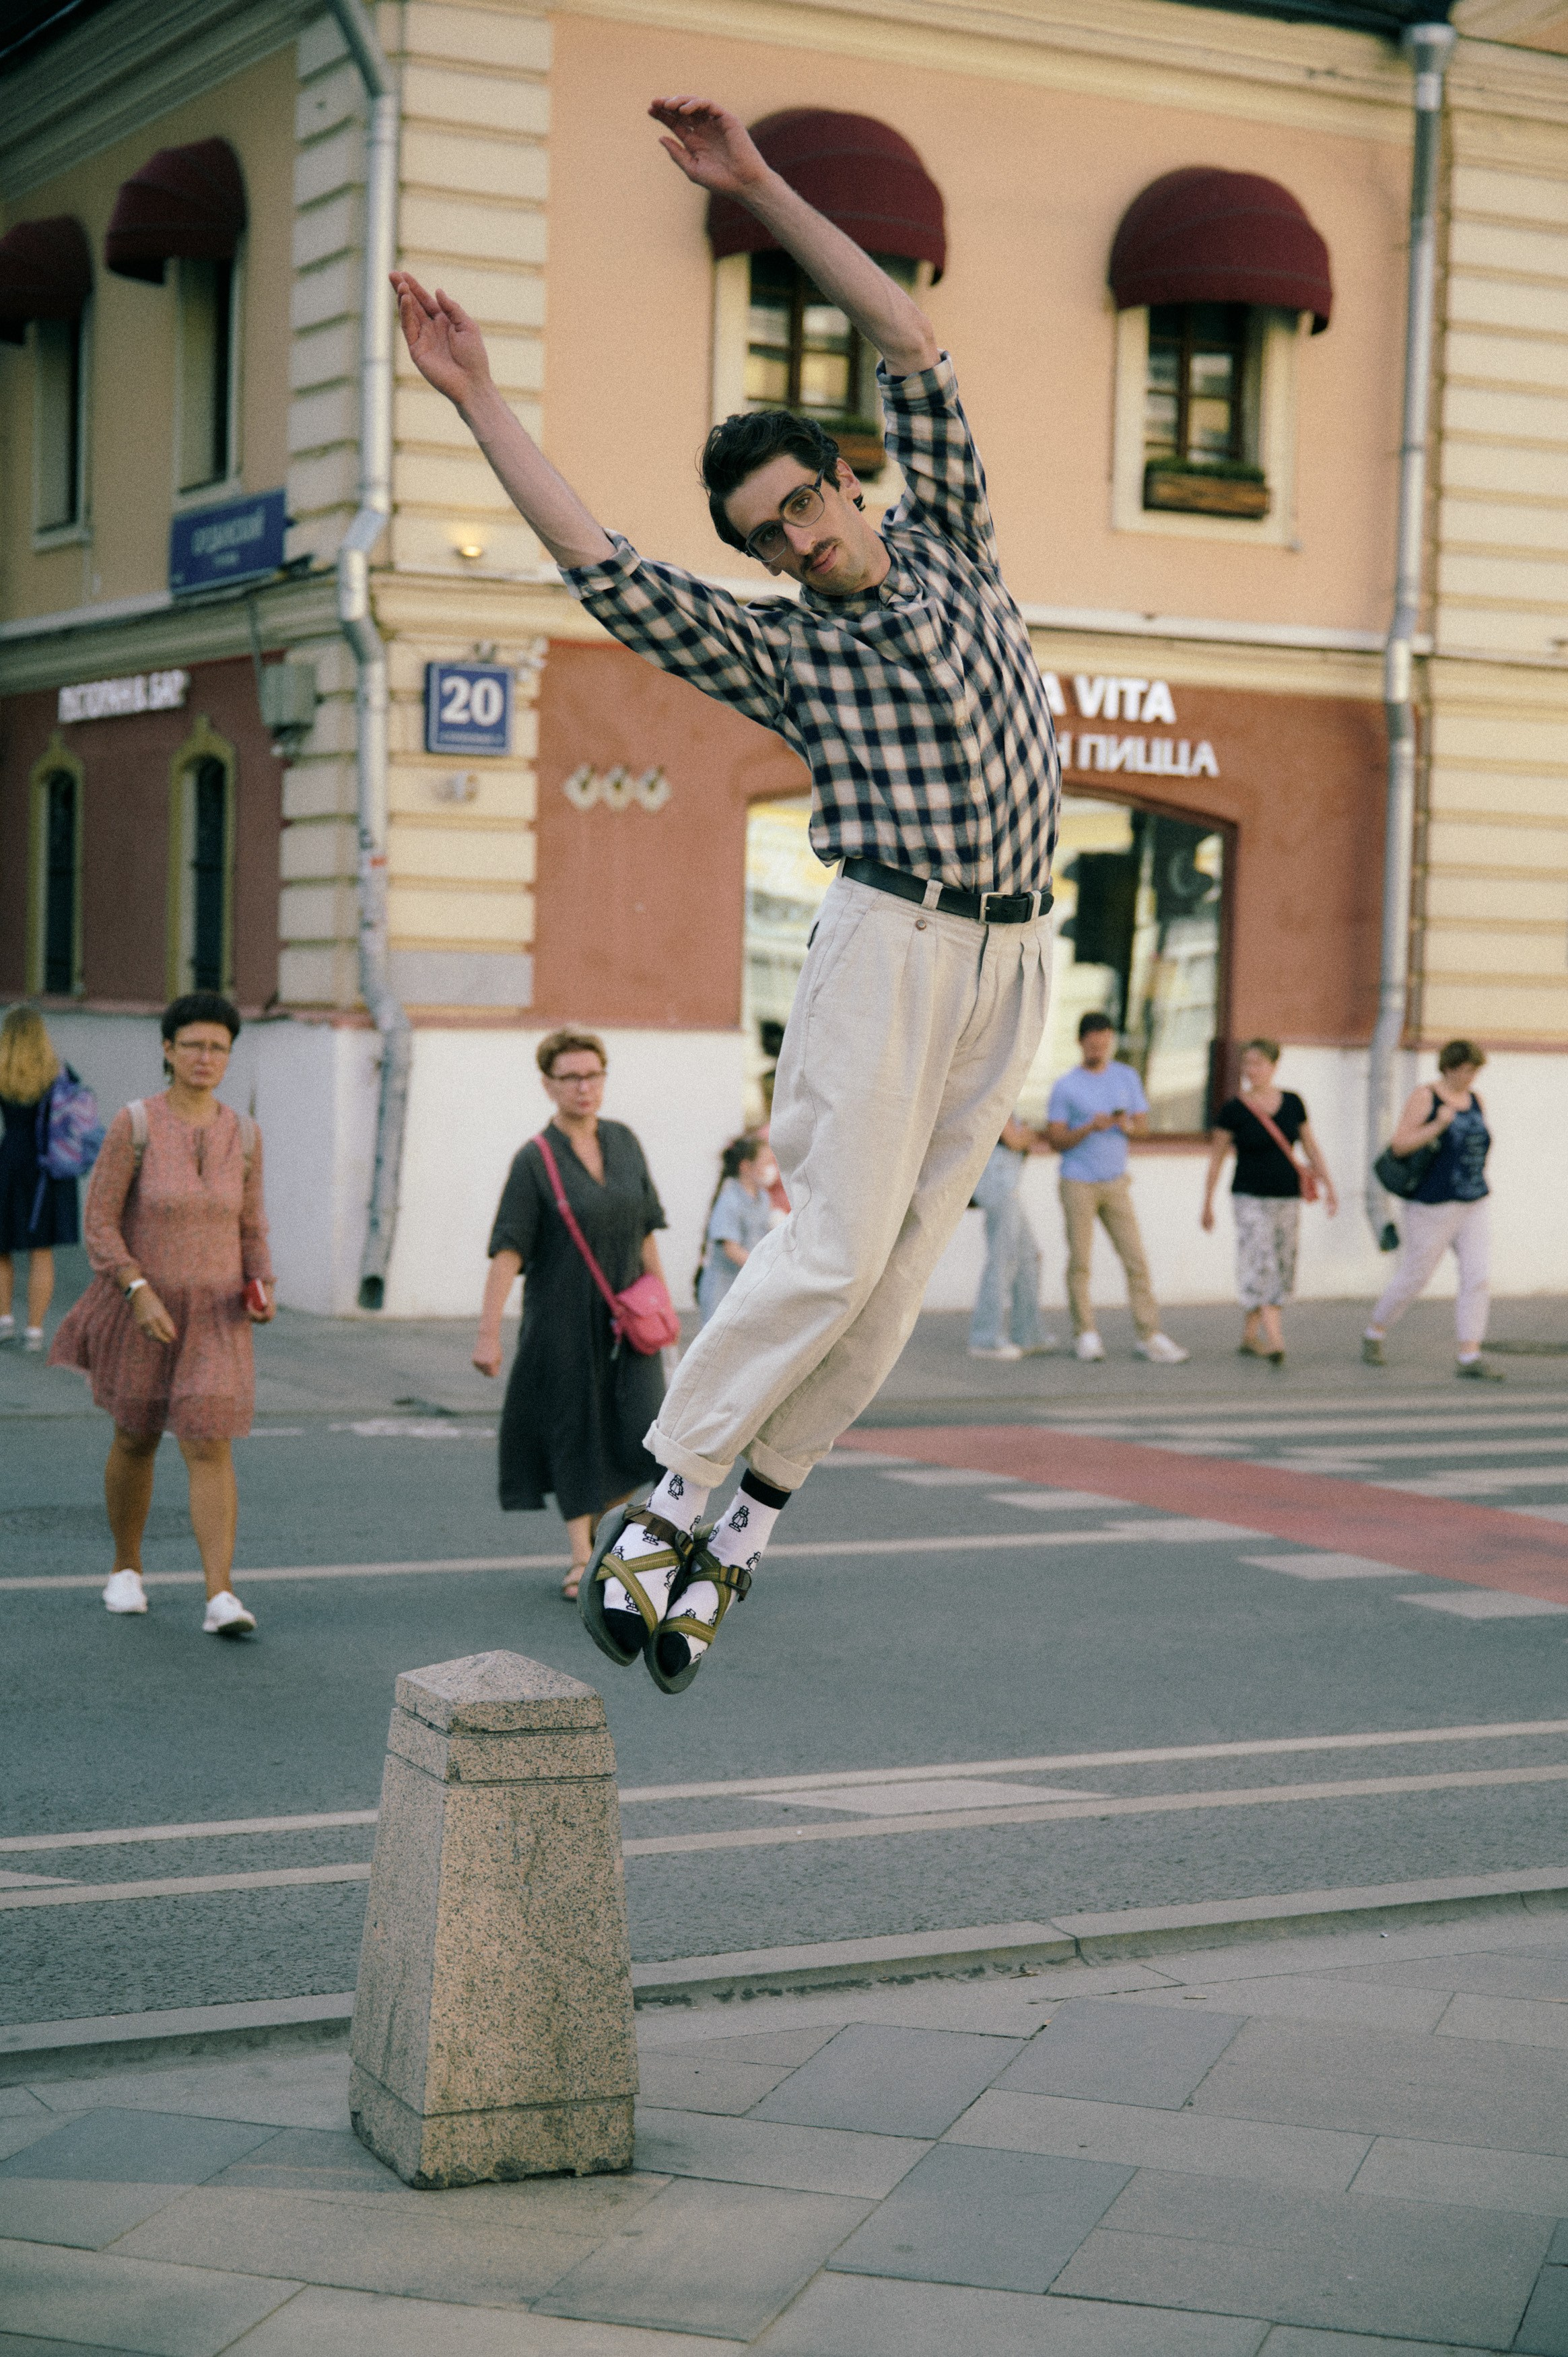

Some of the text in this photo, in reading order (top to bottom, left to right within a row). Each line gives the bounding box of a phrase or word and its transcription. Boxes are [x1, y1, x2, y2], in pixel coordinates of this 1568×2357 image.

[441, 675, 504, 726] 20
[1075, 675, 1176, 723] VITA
[1079, 733, 1219, 776] ПИЦЦА
